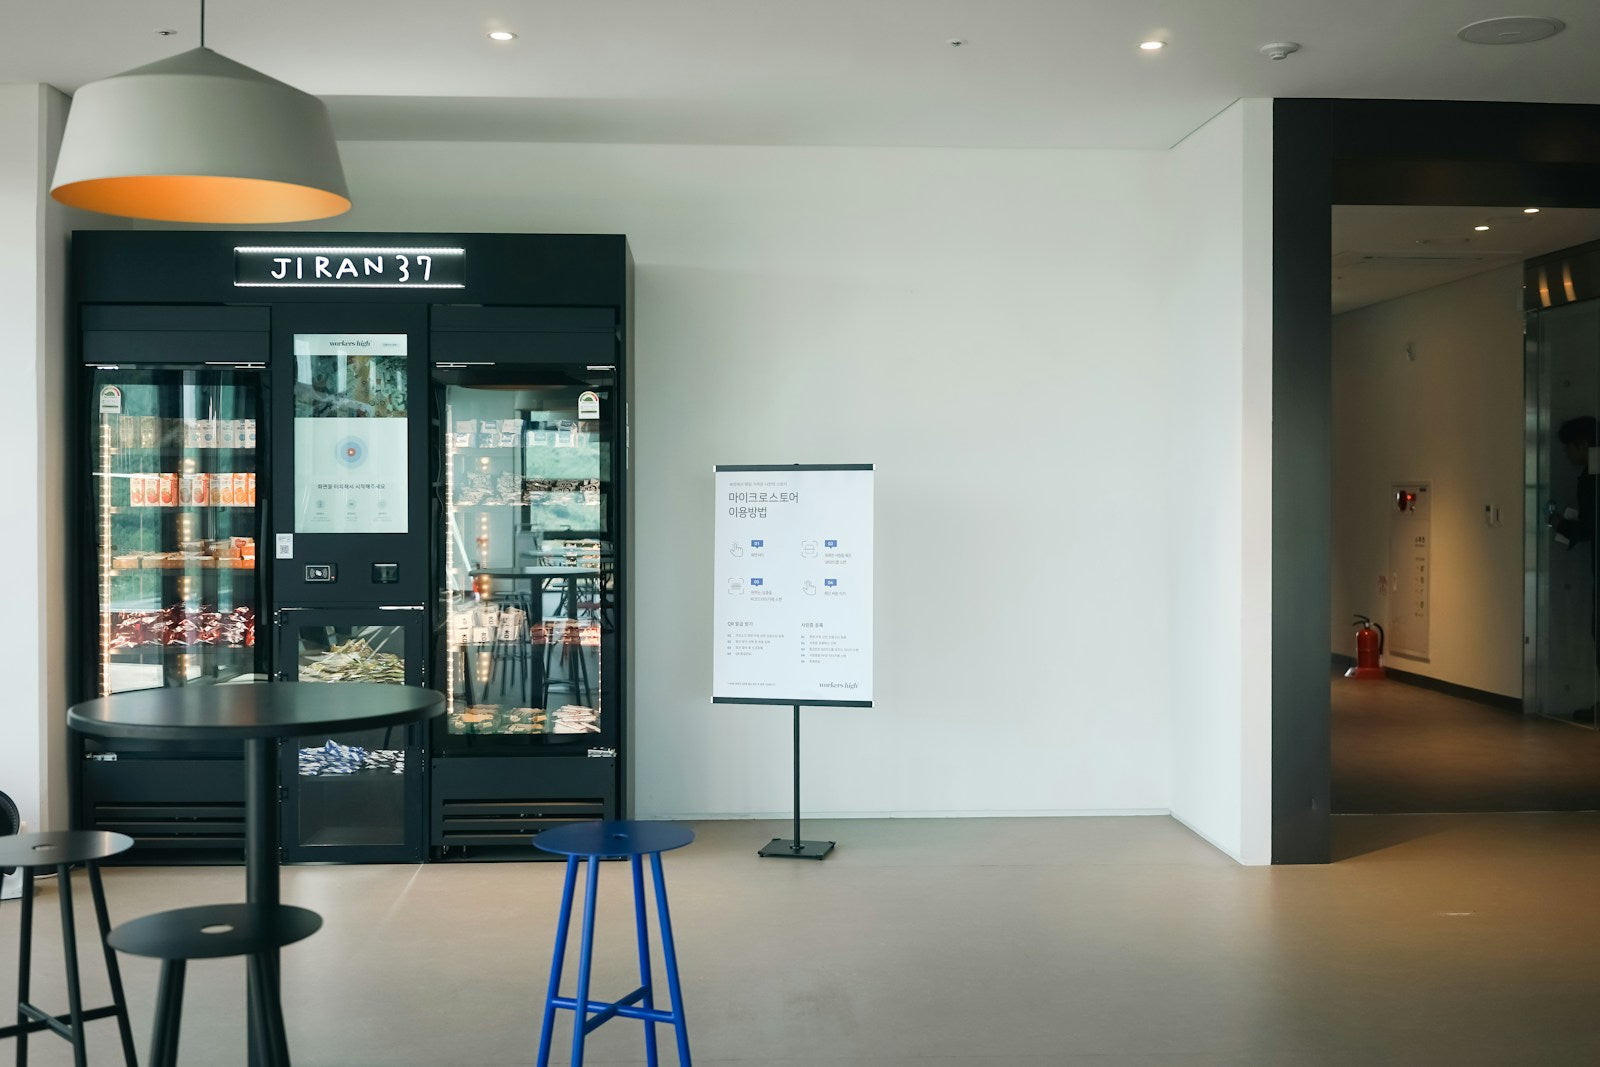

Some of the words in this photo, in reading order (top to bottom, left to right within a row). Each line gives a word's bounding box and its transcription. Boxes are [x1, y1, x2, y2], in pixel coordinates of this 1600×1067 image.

[728, 491, 799, 504] 마이크로스토어
[728, 506, 767, 519] 이용방법
[844, 682, 858, 690] high
